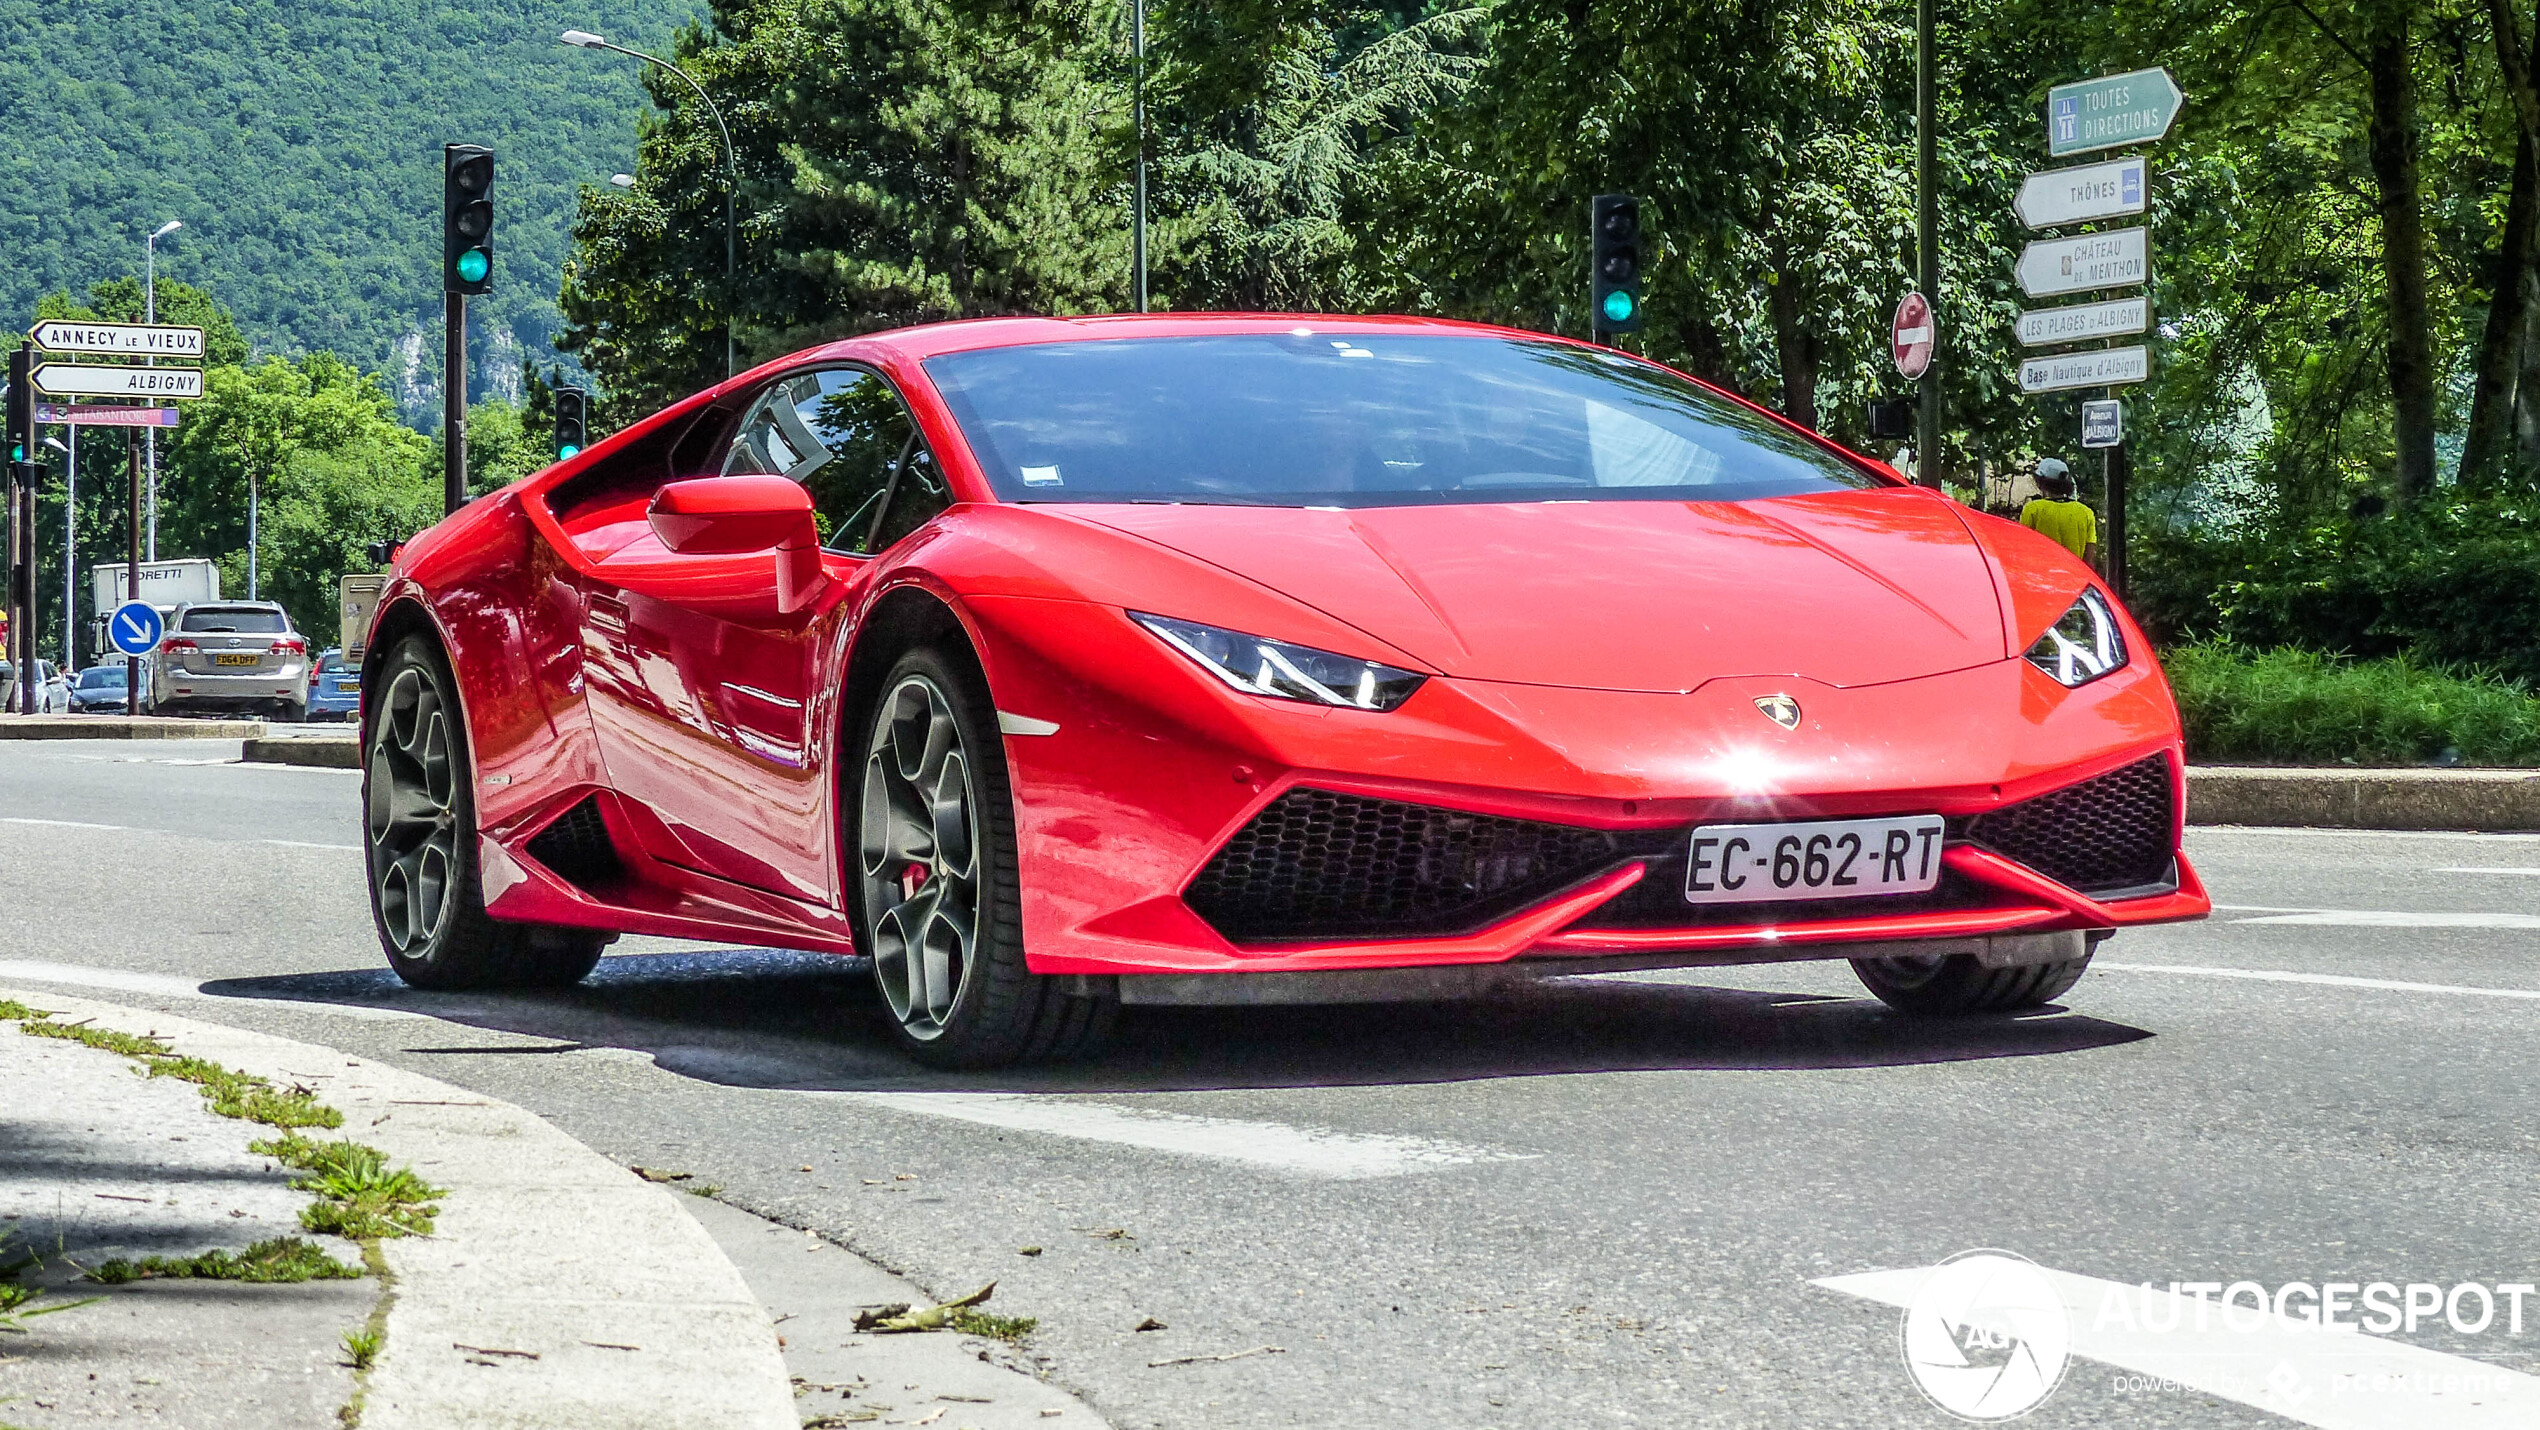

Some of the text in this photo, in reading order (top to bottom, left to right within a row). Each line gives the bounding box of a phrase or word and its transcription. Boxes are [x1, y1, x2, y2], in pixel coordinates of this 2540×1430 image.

[2085, 86, 2130, 113] TOUTES
[2085, 108, 2159, 139] DIRECTIONS
[2071, 181, 2115, 203] THÔNES
[2074, 239, 2121, 262] CHÂTEAU
[2074, 258, 2141, 282] DE MENTHON
[2026, 320, 2043, 337] LES
[2048, 314, 2086, 335] PLAGES
[51, 329, 197, 349] ANNECY LE VIEUX
[128, 374, 196, 391] ALBIGNY
[2027, 358, 2142, 384] Base Nautique d'Albigny
[84, 408, 119, 422] FAISAN
[2090, 410, 2113, 421] Avenue
[1687, 826, 1941, 893] EC-662-RT
